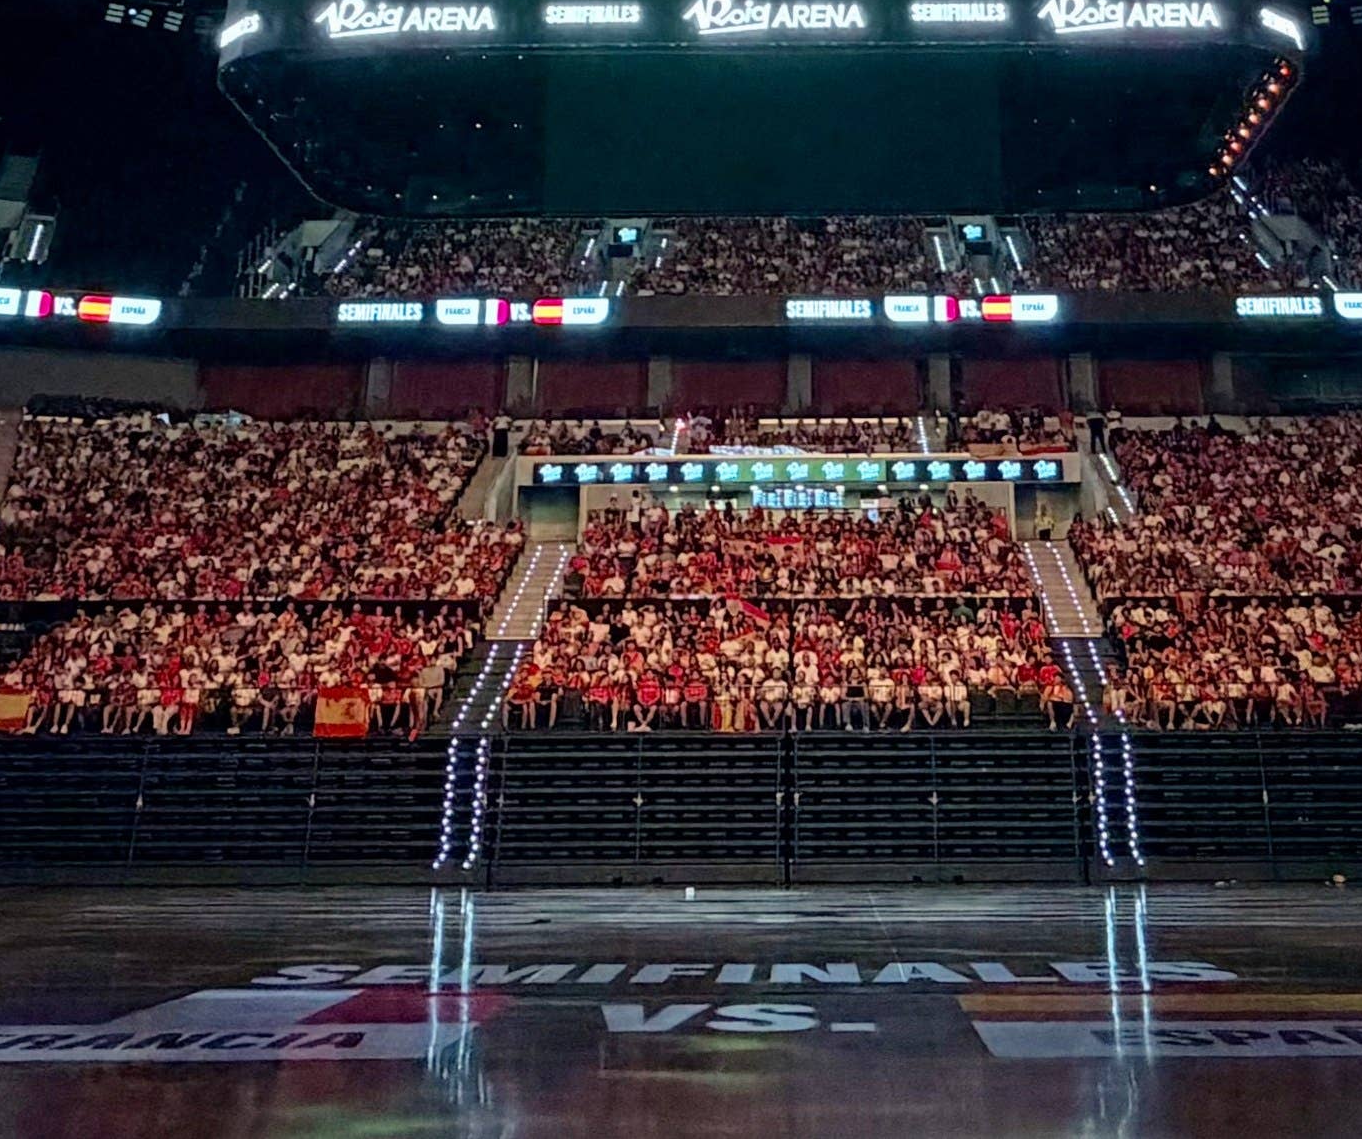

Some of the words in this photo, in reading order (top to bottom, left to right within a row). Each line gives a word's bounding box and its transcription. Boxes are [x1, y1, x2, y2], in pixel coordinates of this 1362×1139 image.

[401, 7, 496, 31] ARENA
[771, 3, 865, 28] ARENA
[1126, 2, 1221, 27] ARENA
[53, 296, 78, 316] VS.
[337, 302, 423, 322] SEMIFINALES
[509, 302, 532, 322] VS.
[786, 299, 872, 320] SEMIFINALES
[958, 299, 982, 319] VS.
[1236, 296, 1323, 316] SEMIFINALES
[250, 961, 1238, 986] SEMIFINALES
[600, 1002, 878, 1033] VS.
